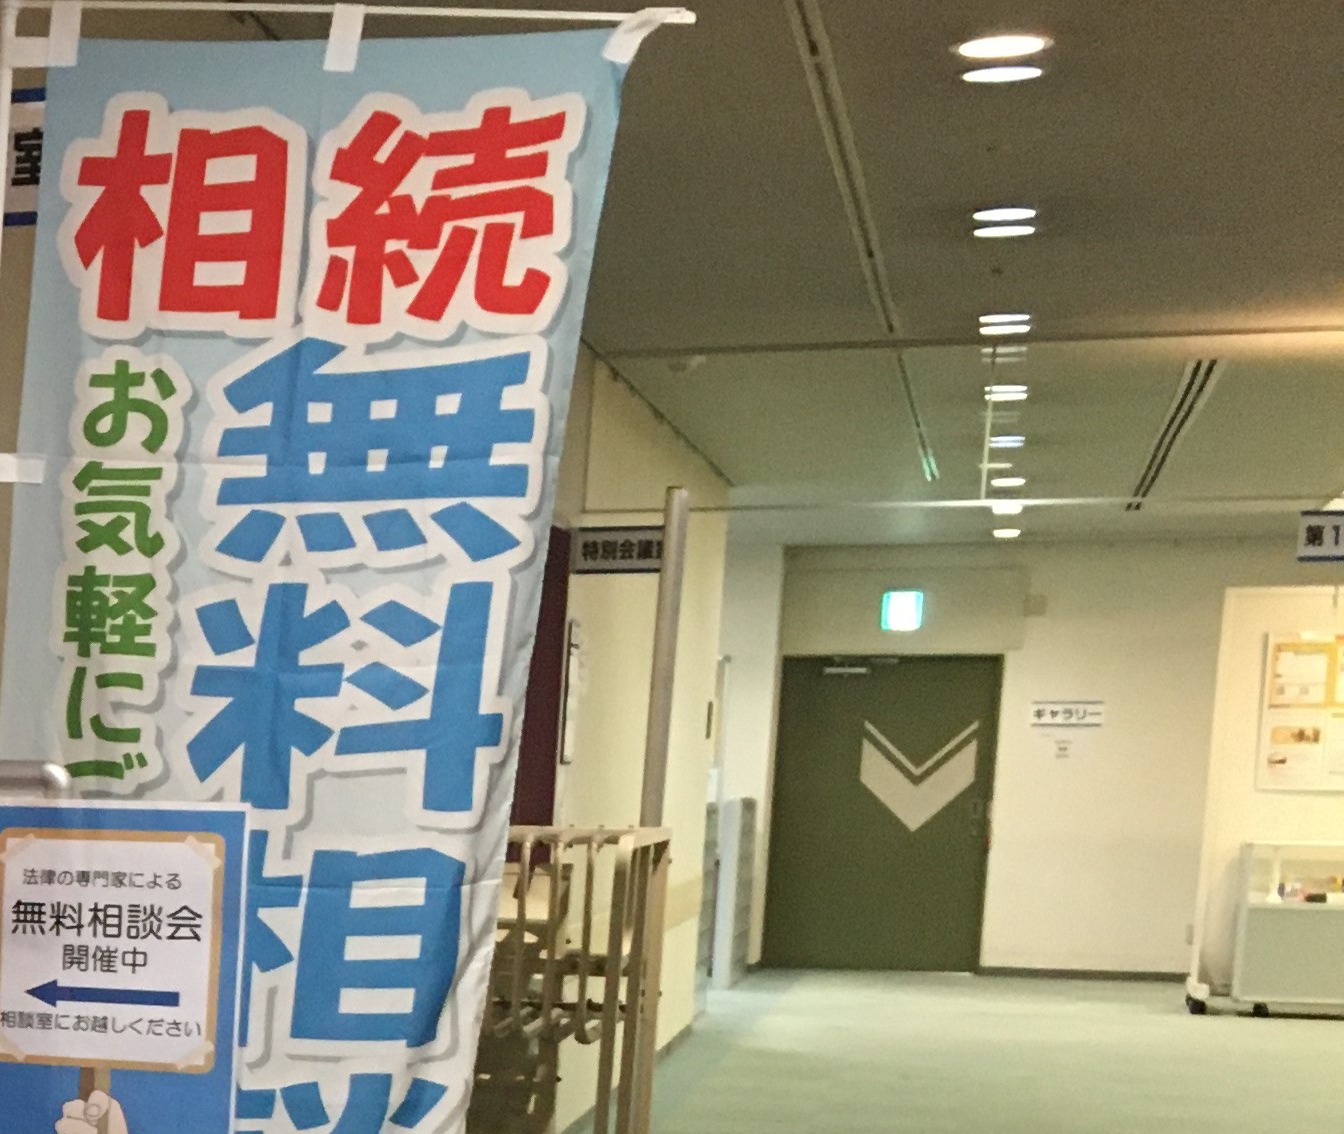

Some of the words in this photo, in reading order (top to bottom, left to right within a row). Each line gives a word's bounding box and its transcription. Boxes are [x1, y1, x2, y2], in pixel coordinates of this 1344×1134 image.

[74, 105, 566, 324] 相続
[1033, 708, 1102, 720] ギャラリー
[22, 868, 182, 890] 法律の専門家による
[11, 900, 203, 942] 無料相談会
[62, 944, 148, 974] 開催中
[0, 1010, 202, 1037] 相談室にお越しください
